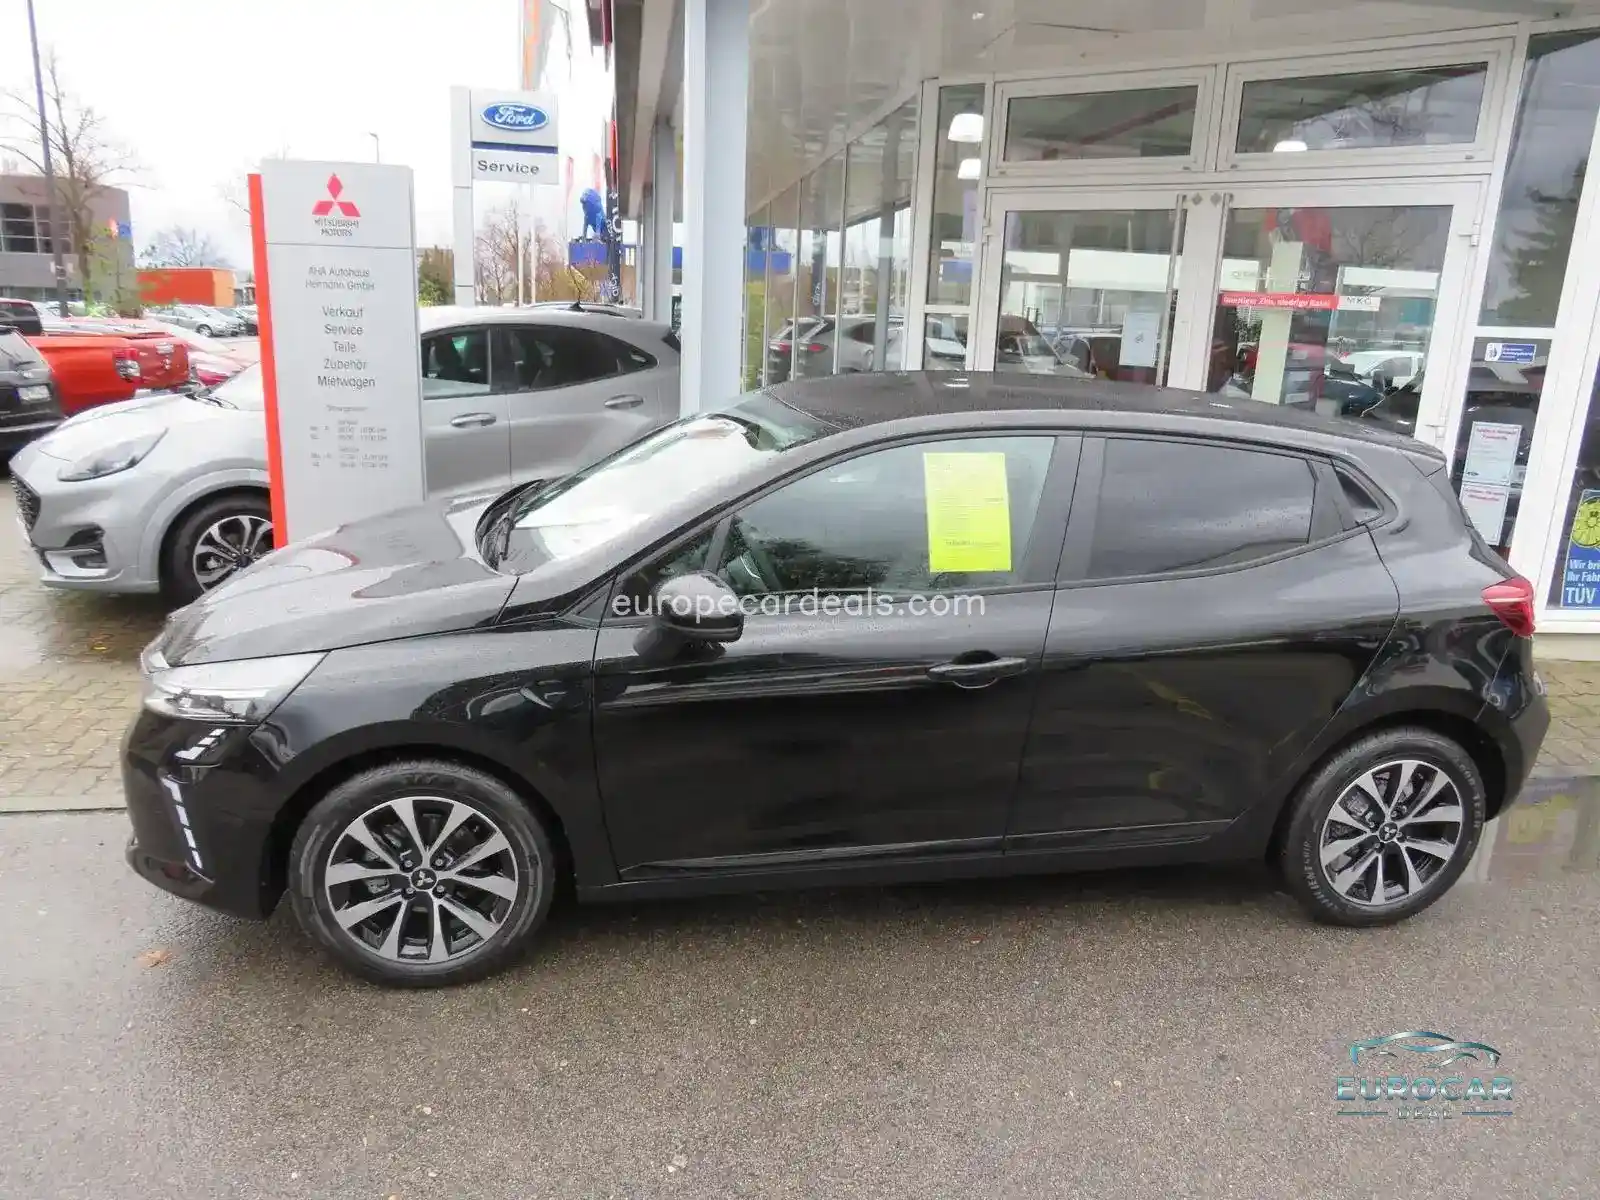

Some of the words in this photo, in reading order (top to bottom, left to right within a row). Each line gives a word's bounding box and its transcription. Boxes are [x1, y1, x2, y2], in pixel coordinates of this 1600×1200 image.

[494, 106, 536, 125] Ford
[477, 159, 540, 174] Service
[321, 228, 353, 237] MOTORS
[330, 267, 370, 277] Autohaus
[347, 280, 375, 291] GmbH
[322, 304, 364, 318] Verkauf
[324, 323, 364, 335] Service
[333, 341, 356, 353] Teile
[323, 358, 368, 370] Zubehör
[317, 375, 376, 390] Mietwagen
[1569, 559, 1586, 569] Wir
[1567, 571, 1580, 582] Ihr
[1565, 583, 1597, 604] TÜV
